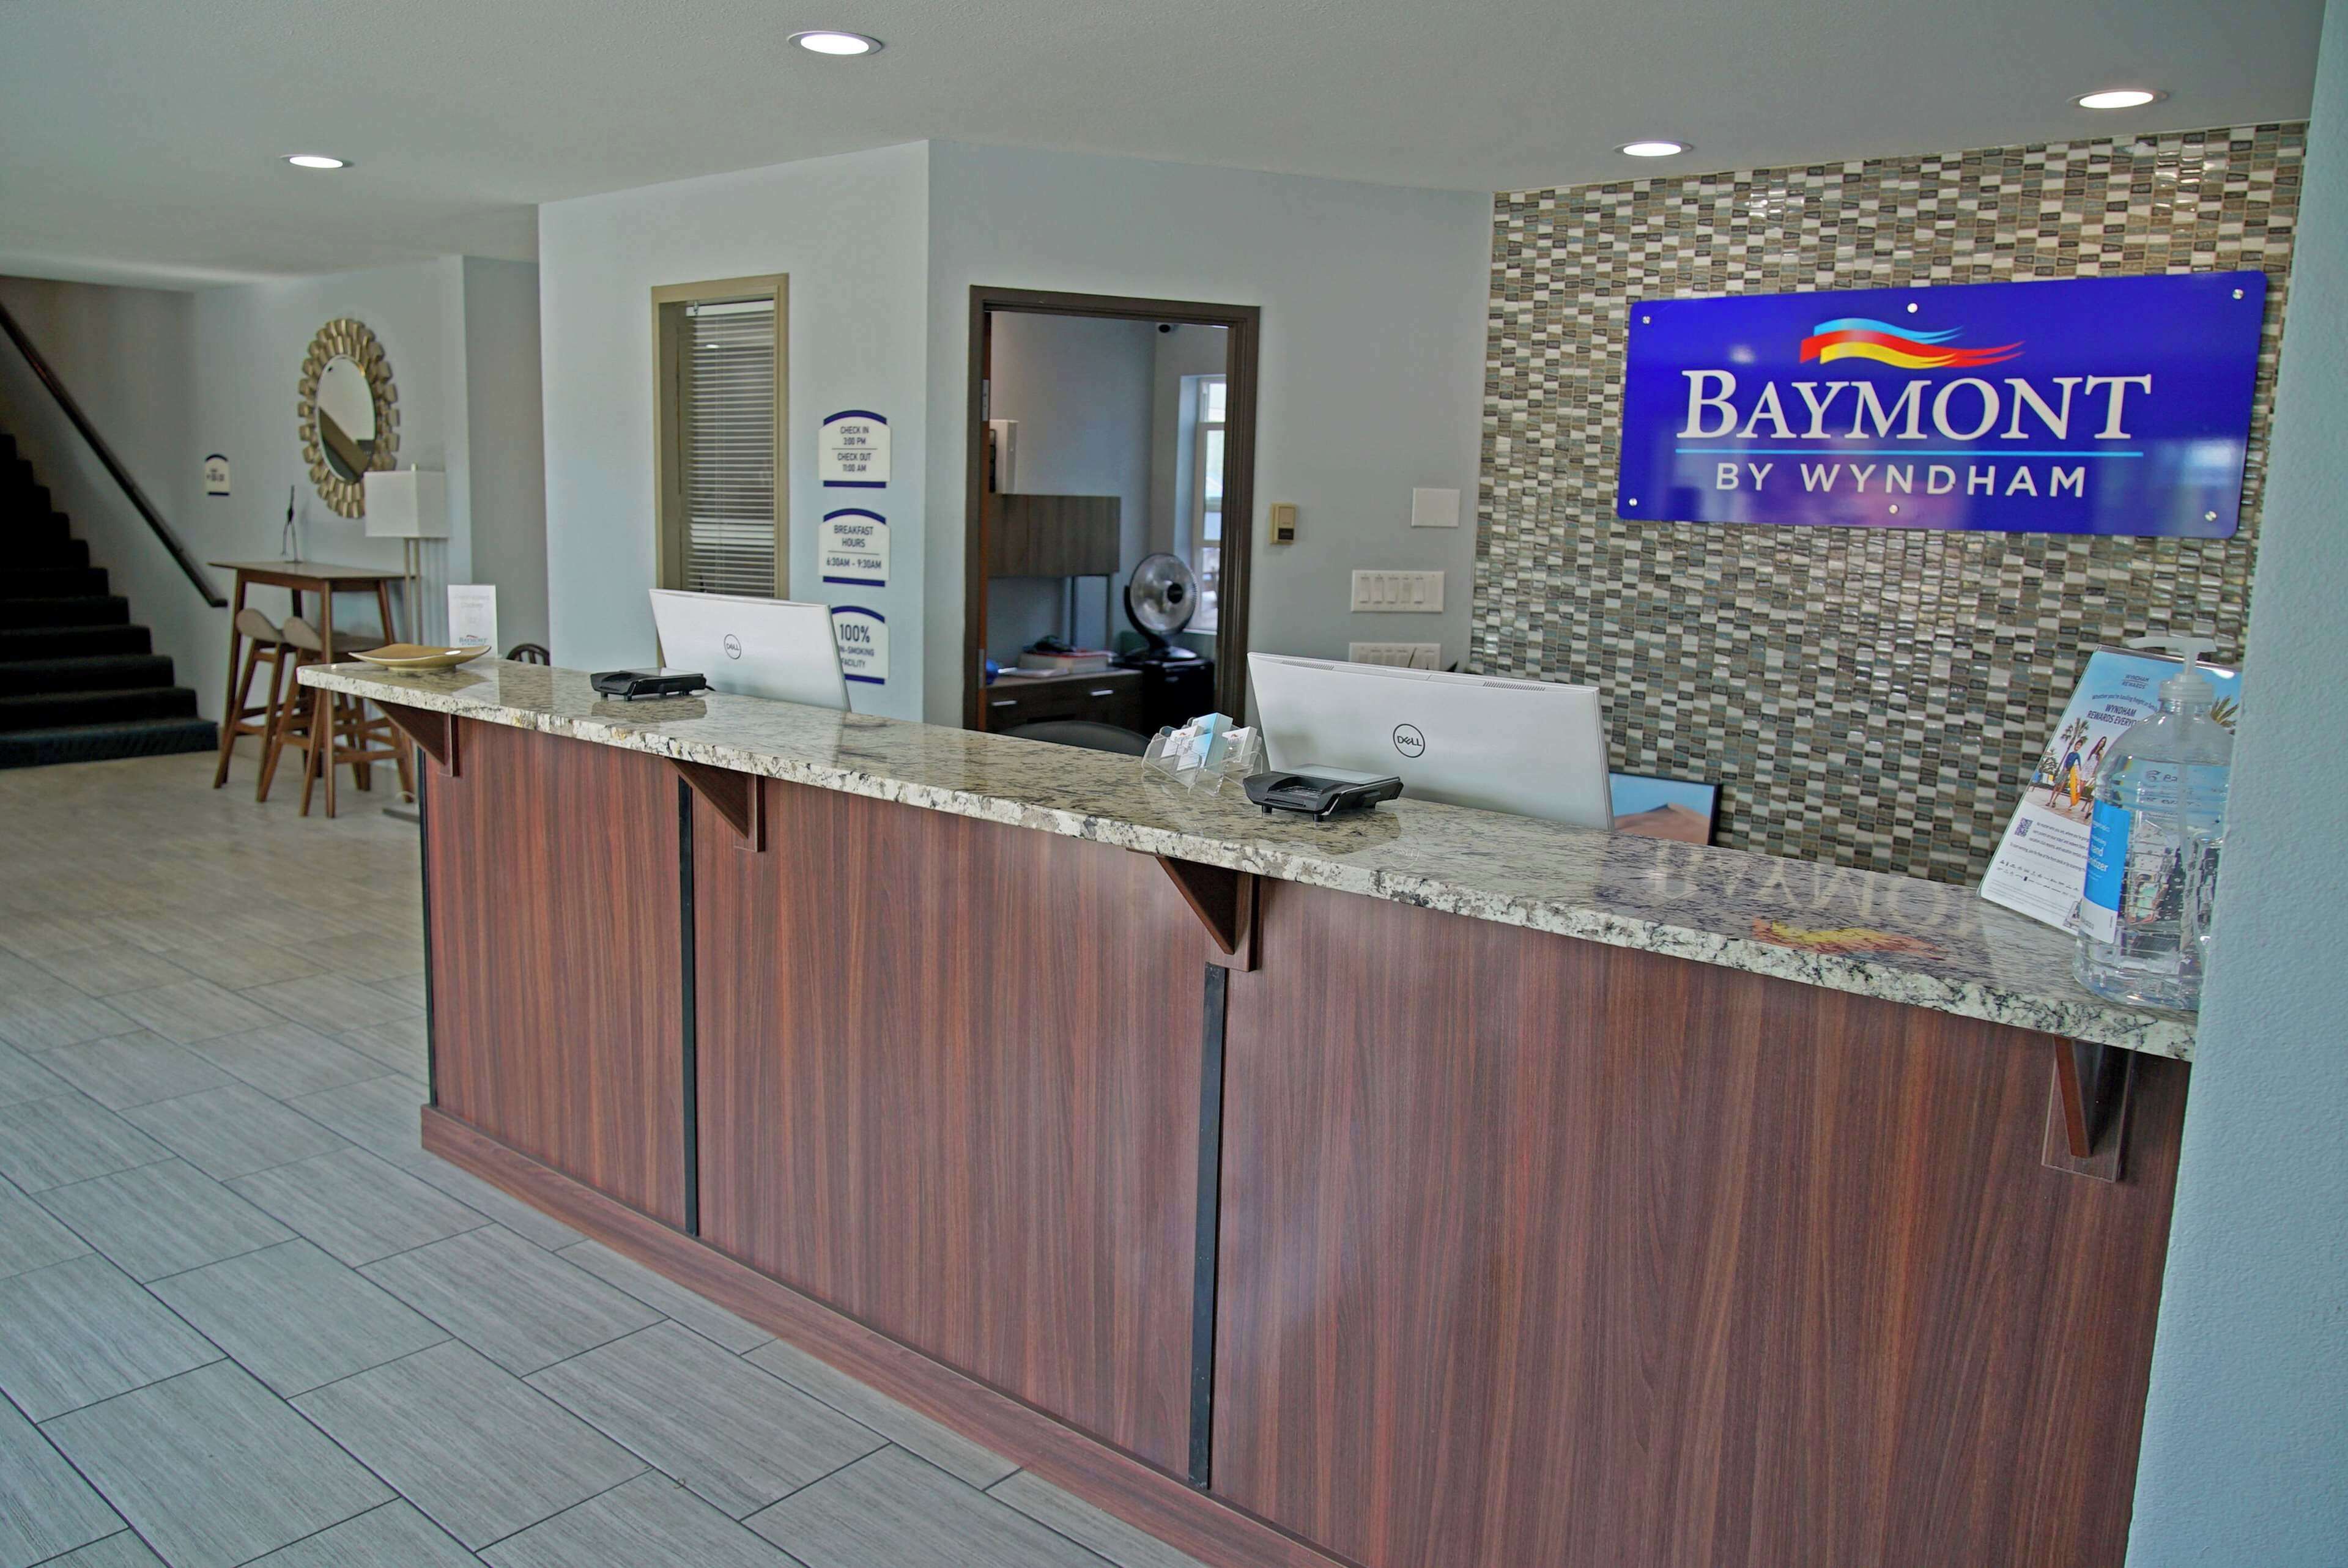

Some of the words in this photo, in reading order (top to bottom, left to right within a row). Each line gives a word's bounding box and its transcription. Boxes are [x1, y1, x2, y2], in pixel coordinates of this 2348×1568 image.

[1675, 369, 2153, 440] BAYMONT
[837, 453, 858, 461] CHECK
[1715, 462, 1773, 490] BY
[1800, 463, 2086, 498] WYNDHAM
[834, 525, 873, 535] BREAKFAST
[842, 538, 865, 548] HOURS
[840, 624, 870, 643] 100%
[839, 645, 875, 657] N-SMOKING
[2087, 710, 2114, 723] REWARDS
[2105, 704, 2137, 717] WYNDHAM
[1396, 735, 1422, 747] DELL
